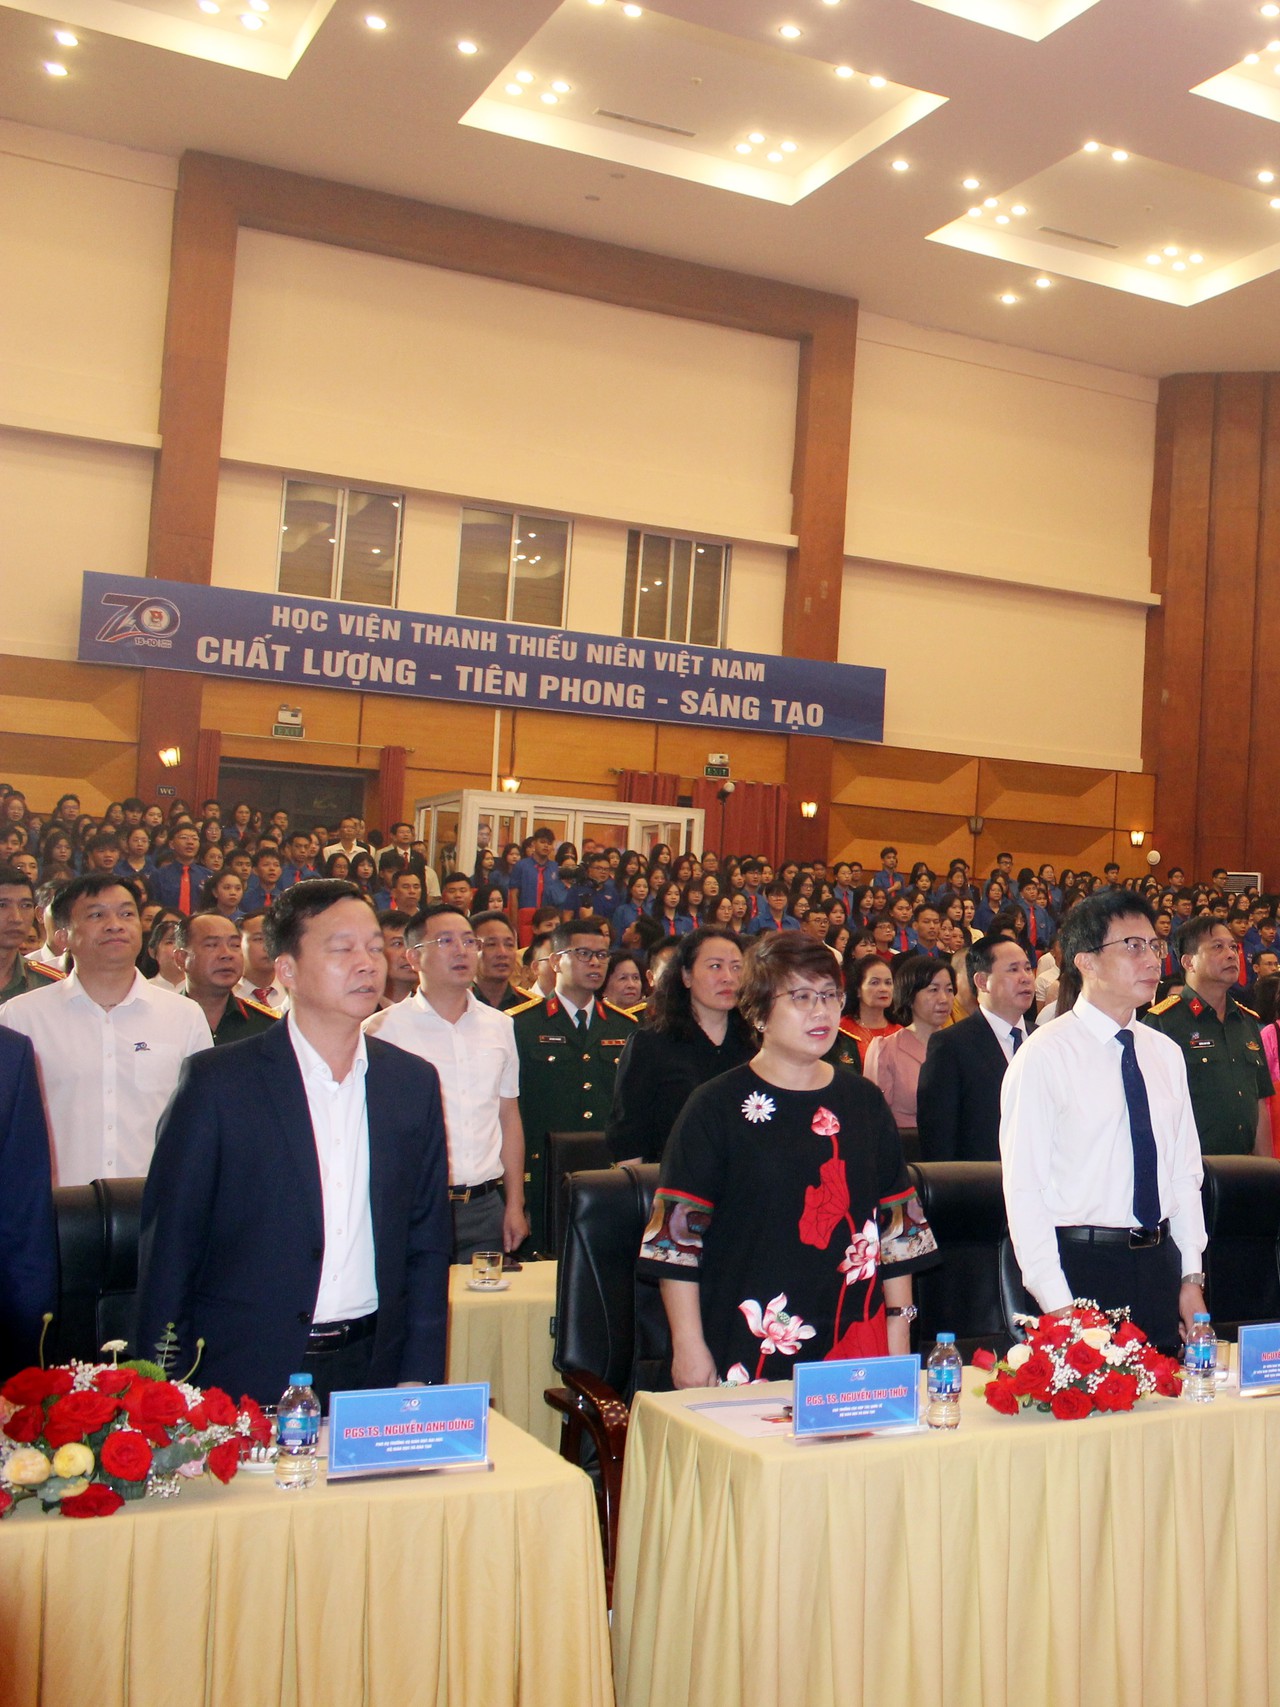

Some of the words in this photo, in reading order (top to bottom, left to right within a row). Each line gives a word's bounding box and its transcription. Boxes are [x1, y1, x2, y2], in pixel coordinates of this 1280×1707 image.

[272, 605, 328, 635] HỌC
[339, 613, 401, 643] VIỆN
[411, 622, 497, 652] THANH
[507, 633, 578, 661] THIẾU
[586, 643, 646, 669] NIÊN
[654, 650, 704, 678] VIỆT
[711, 658, 766, 682] NAM
[196, 634, 290, 671] CHẤT
[303, 649, 417, 686] LƯỢNG
[455, 664, 527, 697] TIÊN
[538, 674, 646, 710] PHONG
[680, 687, 760, 721] SÁNG
[771, 699, 825, 730] TẠO
[840, 1387, 871, 1403] NGUYỄN
[873, 1389, 887, 1400] THU
[384, 1418, 423, 1436] NGUYỄN
[425, 1421, 446, 1433] ANH
[447, 1417, 475, 1431] DŨNG
